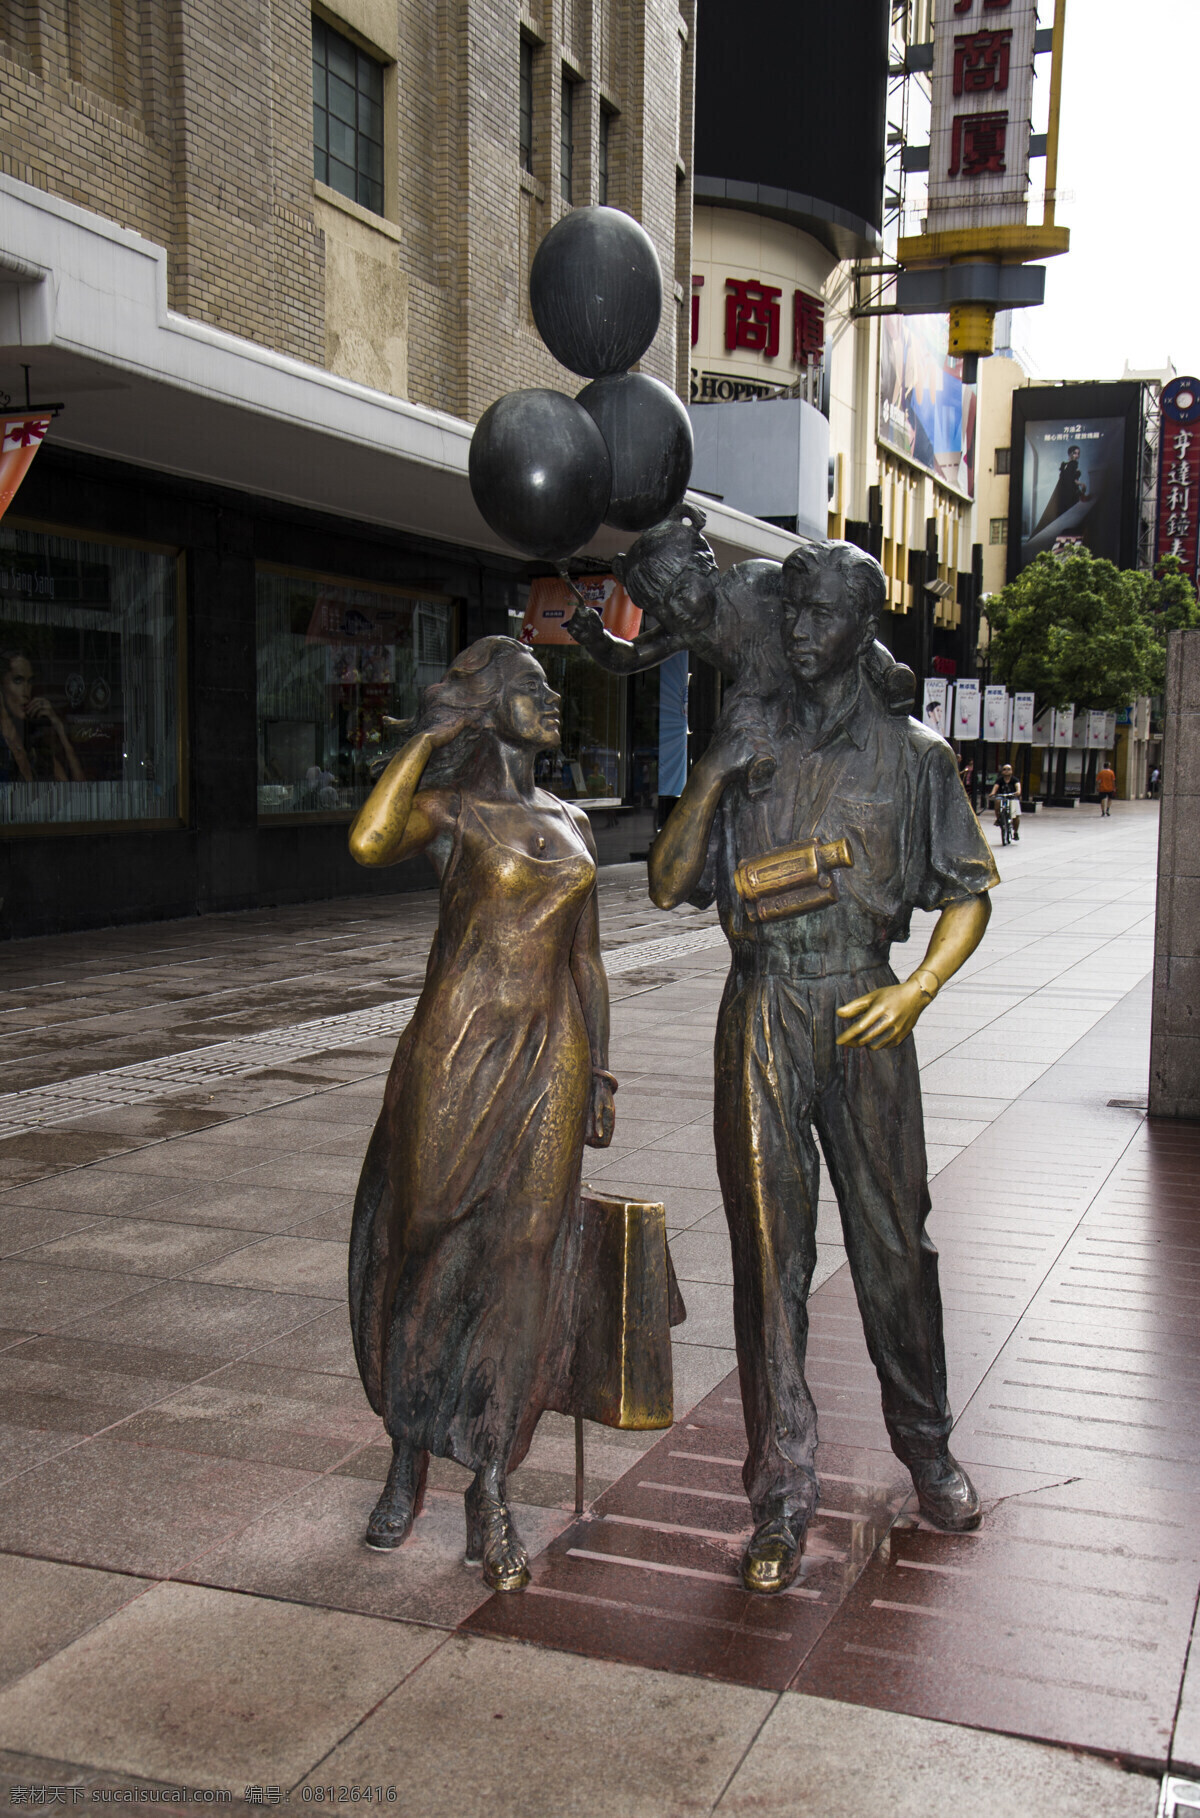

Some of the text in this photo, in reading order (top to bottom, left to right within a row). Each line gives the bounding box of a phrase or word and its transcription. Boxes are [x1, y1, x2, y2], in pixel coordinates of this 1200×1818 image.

[948, 0, 1013, 176] 商厦
[692, 275, 825, 366] 商厦
[10, 567, 32, 597] Sang
[33, 569, 55, 600] Sang
